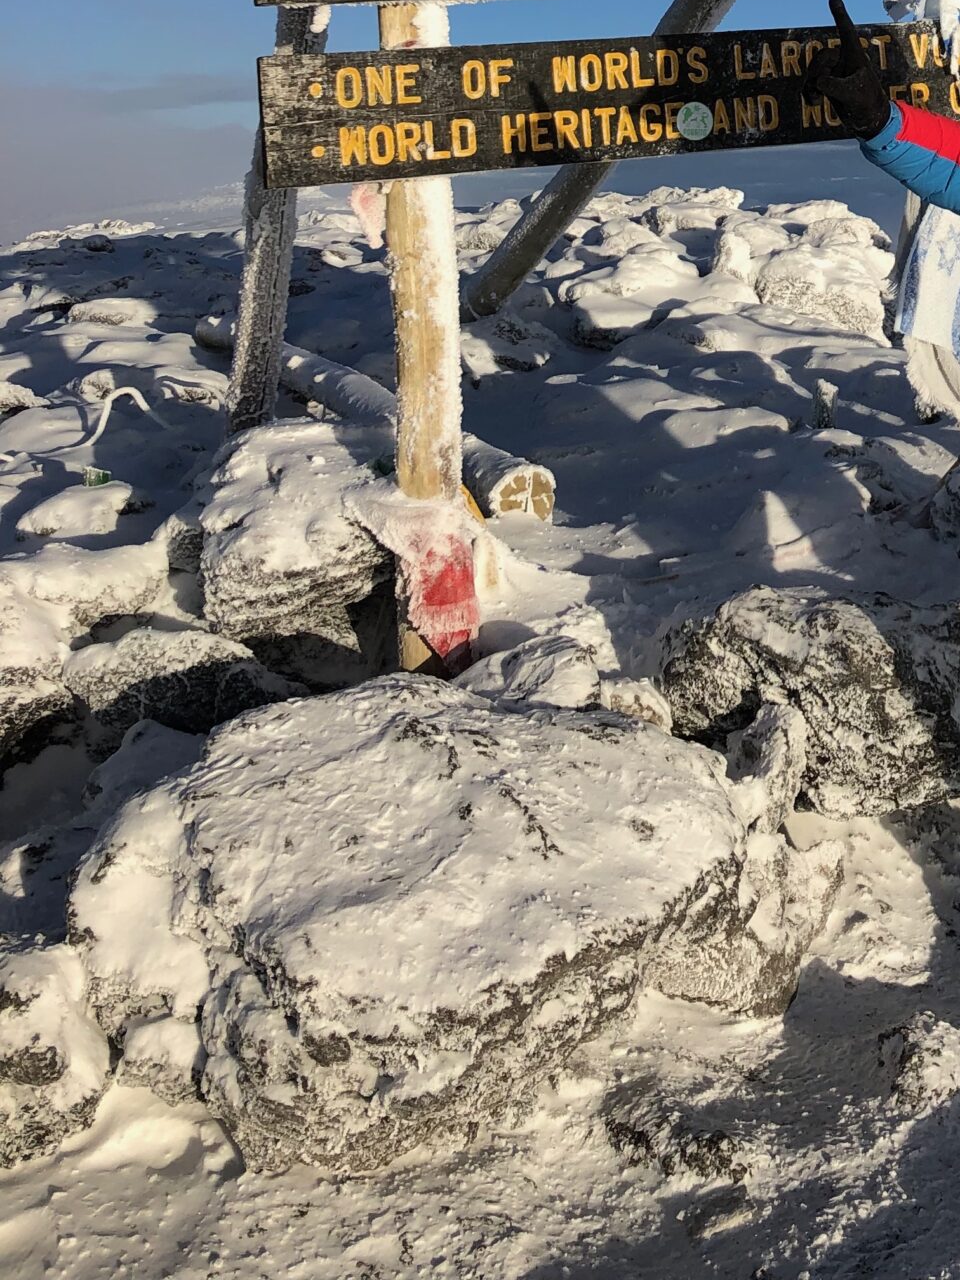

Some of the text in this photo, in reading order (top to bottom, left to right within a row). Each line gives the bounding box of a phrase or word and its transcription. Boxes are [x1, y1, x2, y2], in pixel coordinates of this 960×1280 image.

[335, 64, 422, 109] ONE
[462, 58, 514, 100] OF
[552, 45, 709, 93] WORLD'S
[733, 34, 892, 80] LART
[339, 118, 478, 166] WORLD
[502, 102, 684, 154] HERITAGE
[712, 94, 779, 135] AND
